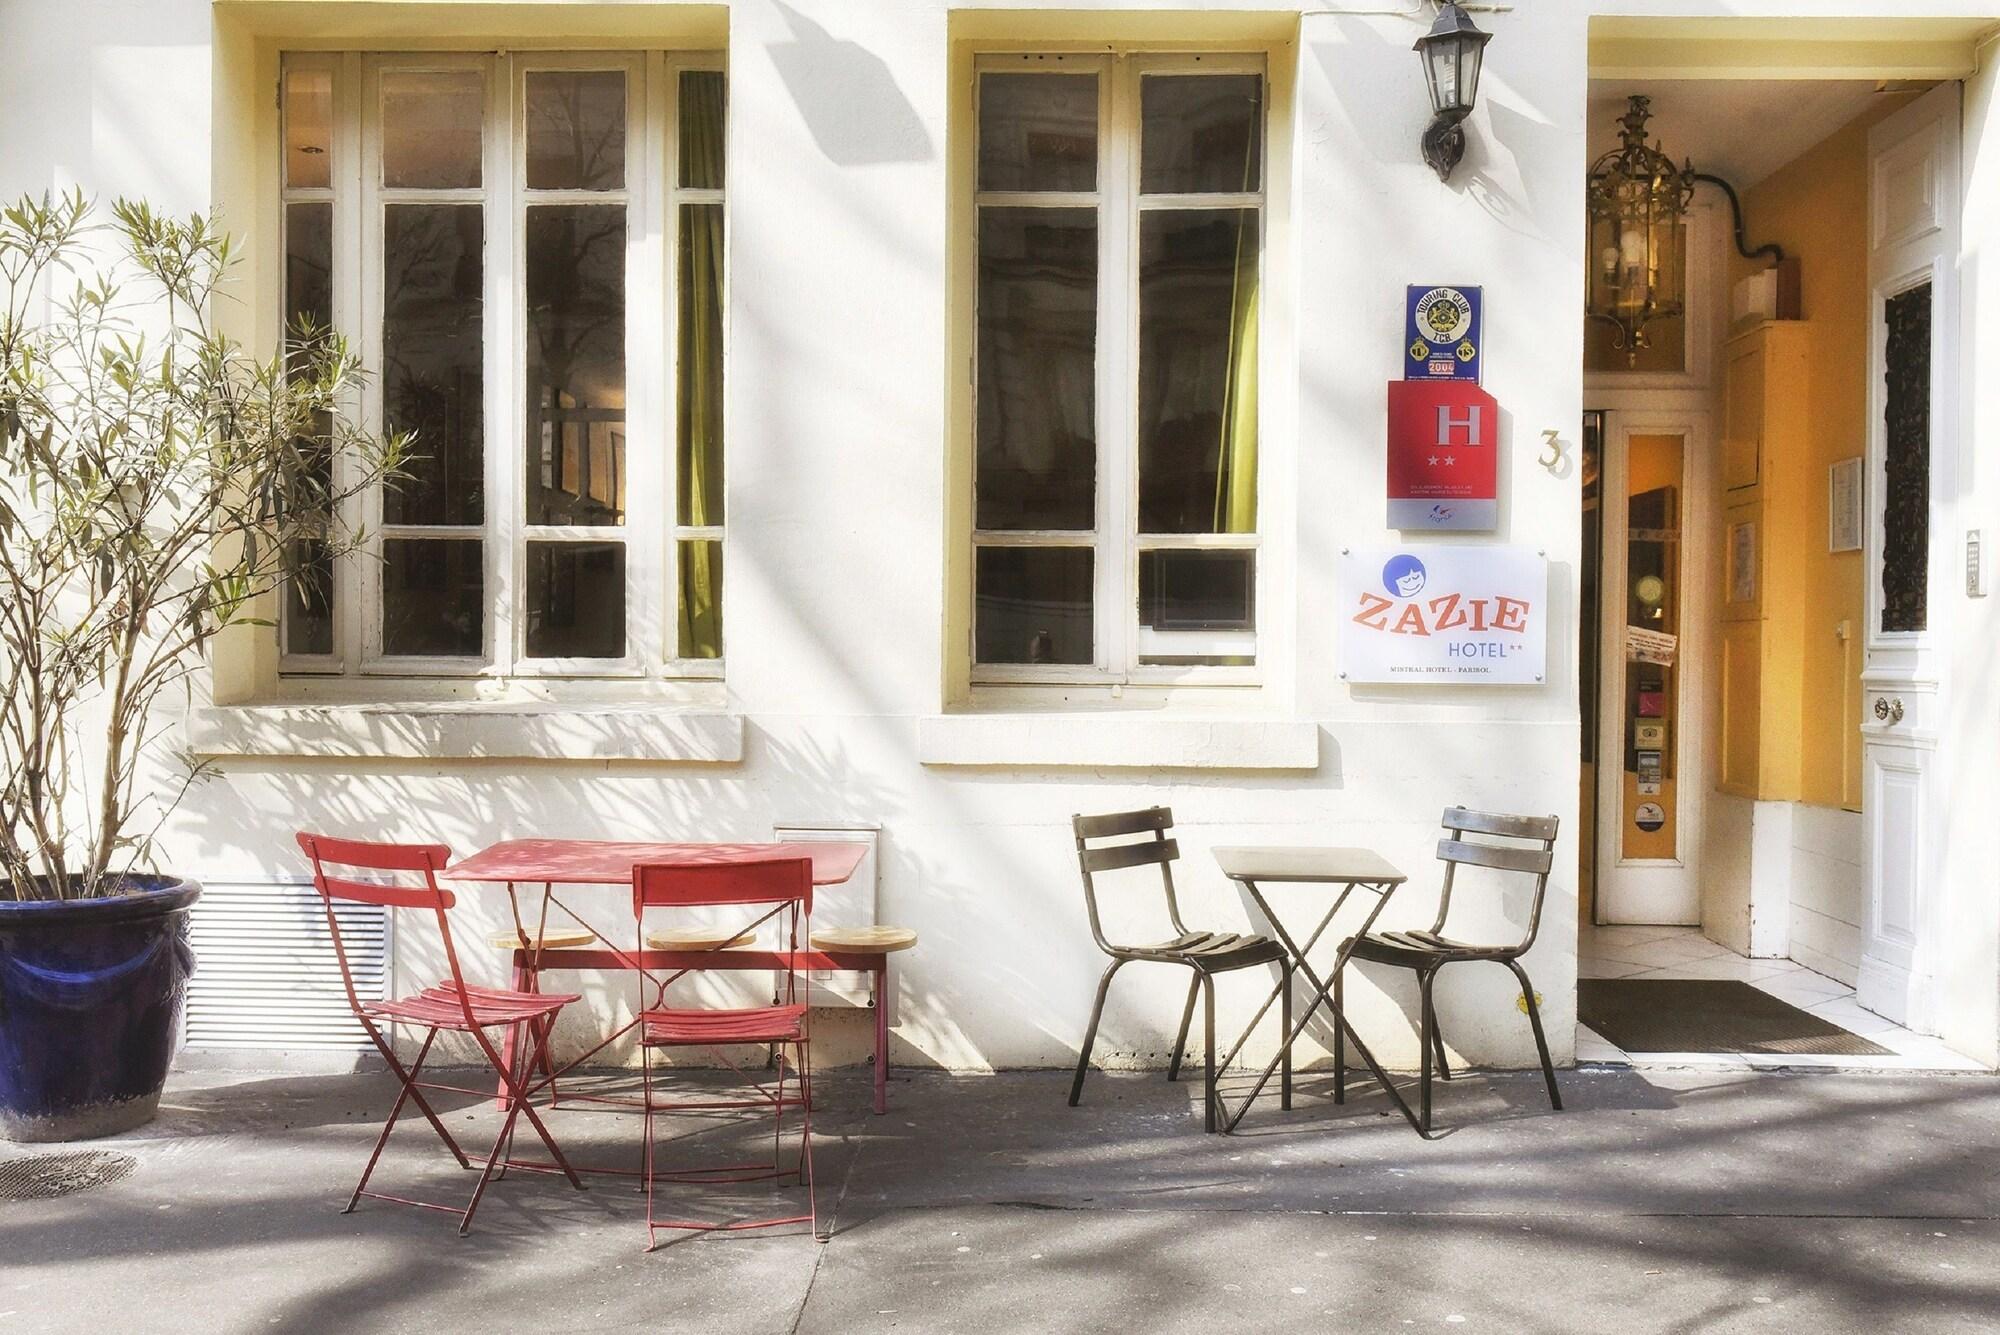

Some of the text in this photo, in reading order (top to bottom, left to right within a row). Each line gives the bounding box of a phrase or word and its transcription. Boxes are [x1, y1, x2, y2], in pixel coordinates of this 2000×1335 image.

[1417, 289, 1470, 314] TOURING CLUB
[1436, 405, 1486, 445] H
[1538, 429, 1561, 467] 3
[1352, 592, 1530, 636] ZAZIE
[1448, 642, 1507, 658] HOTEL
